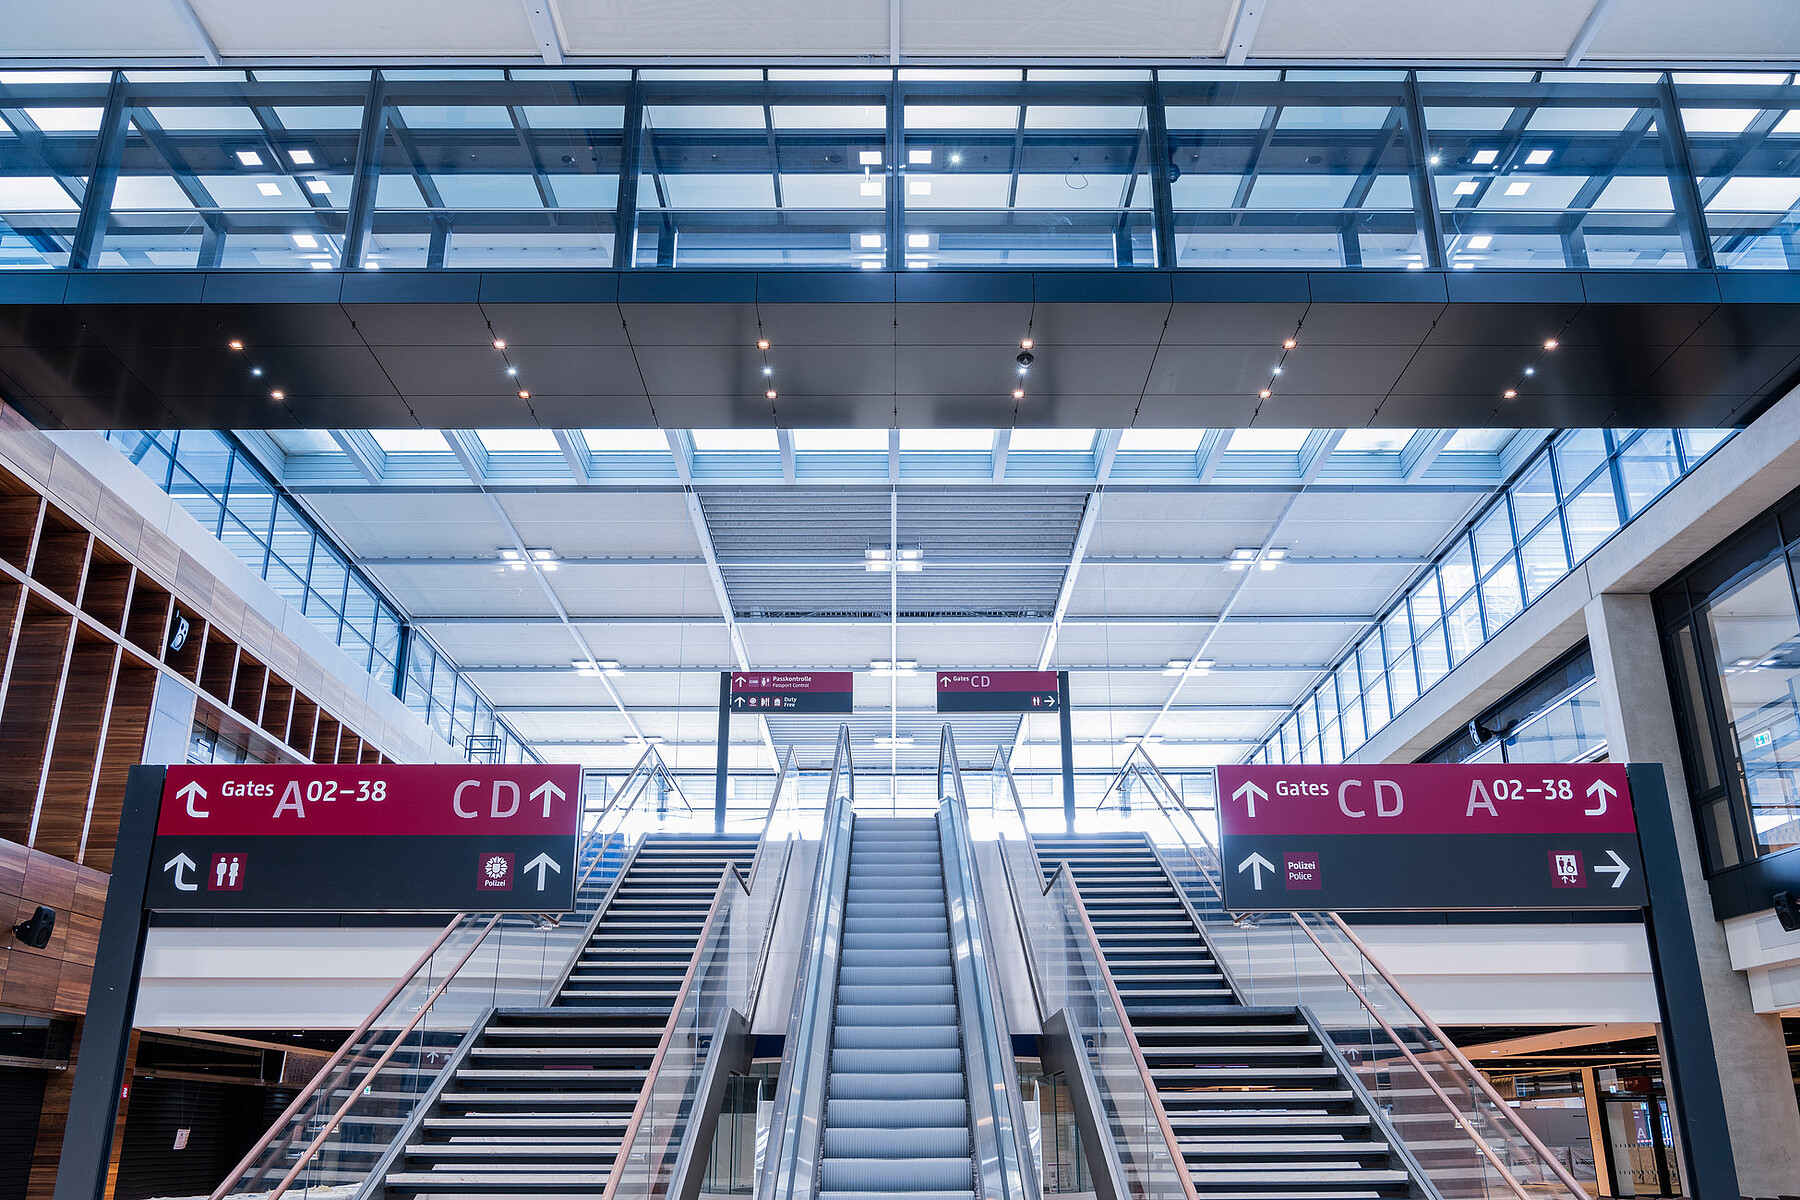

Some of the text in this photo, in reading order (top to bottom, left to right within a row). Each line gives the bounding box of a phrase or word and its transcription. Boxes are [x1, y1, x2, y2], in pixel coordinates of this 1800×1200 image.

[221, 780, 274, 797] Gates
[1276, 780, 1329, 796] Gates
[1288, 861, 1316, 870] Polizei
[1289, 872, 1312, 881] Police
[1637, 1127, 1647, 1139] A
